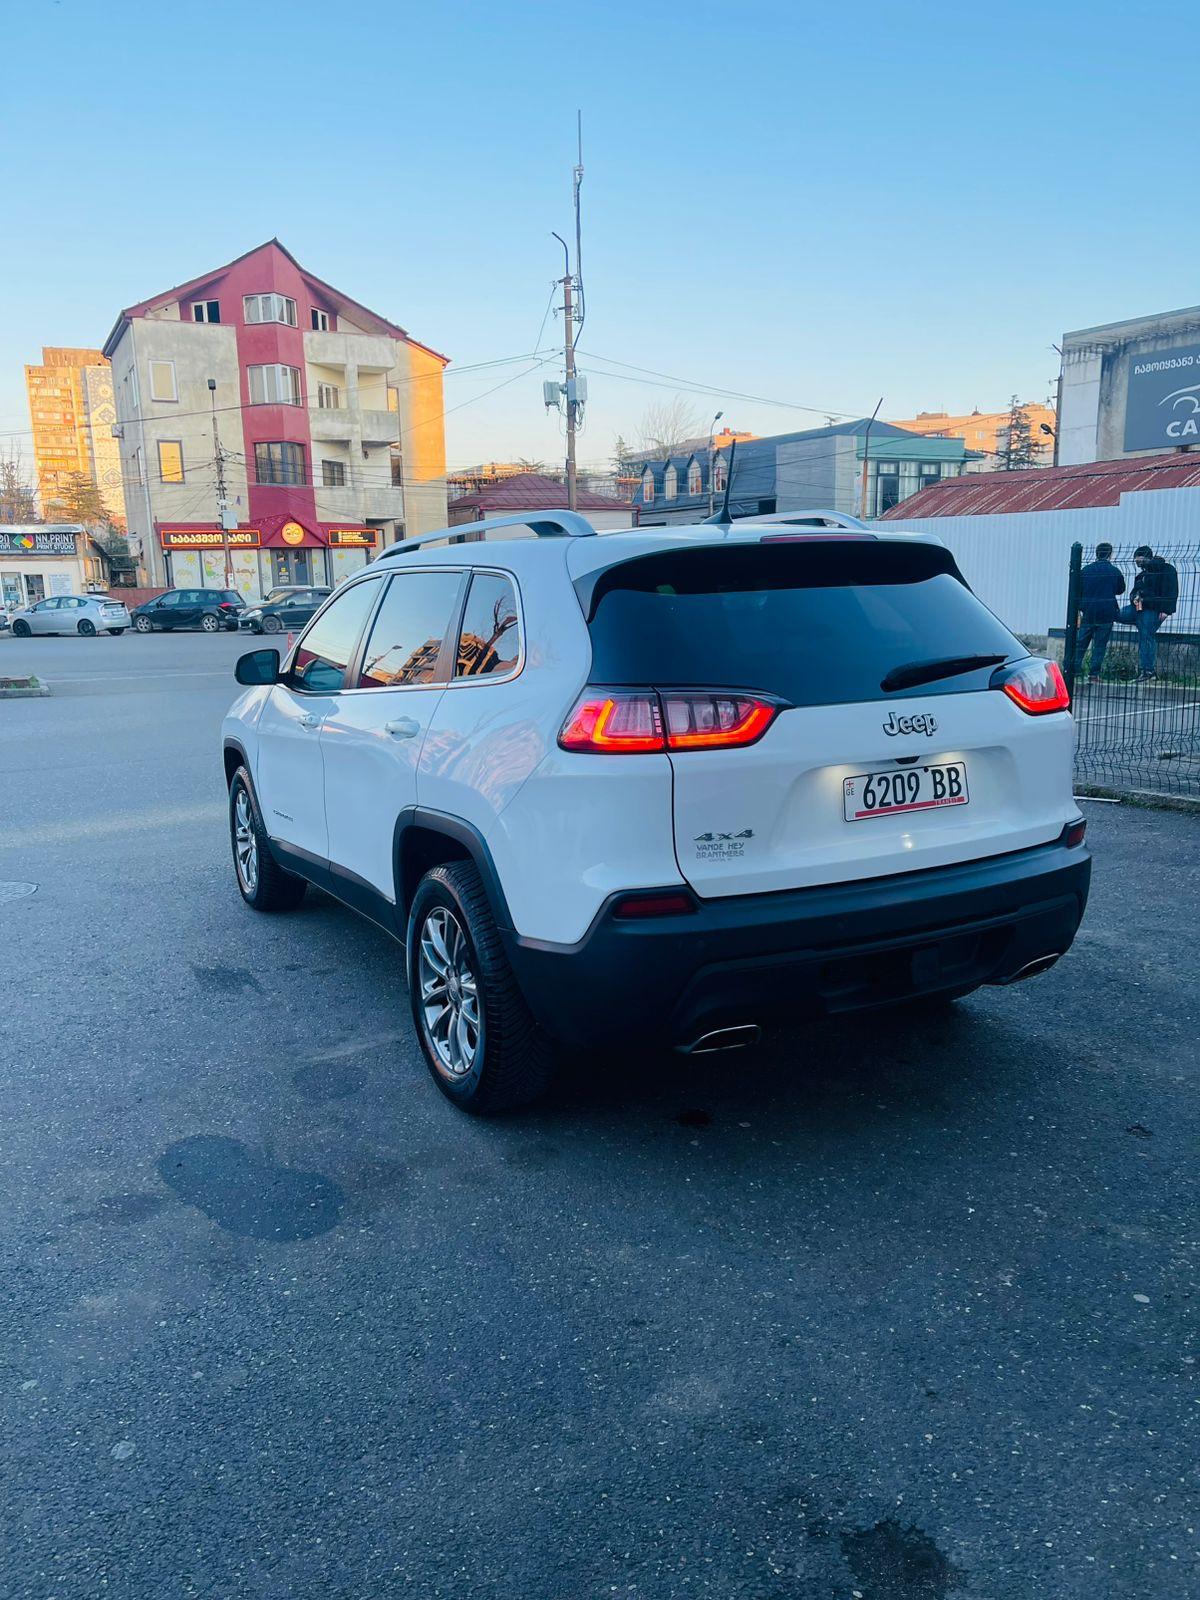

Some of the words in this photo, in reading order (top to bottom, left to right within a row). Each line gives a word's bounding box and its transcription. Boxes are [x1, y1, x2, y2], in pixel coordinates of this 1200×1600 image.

[883, 711, 938, 737] Jeep
[846, 788, 855, 796] GE
[863, 772, 920, 809] 6209
[931, 766, 962, 800] BB
[727, 842, 745, 850] HEY
